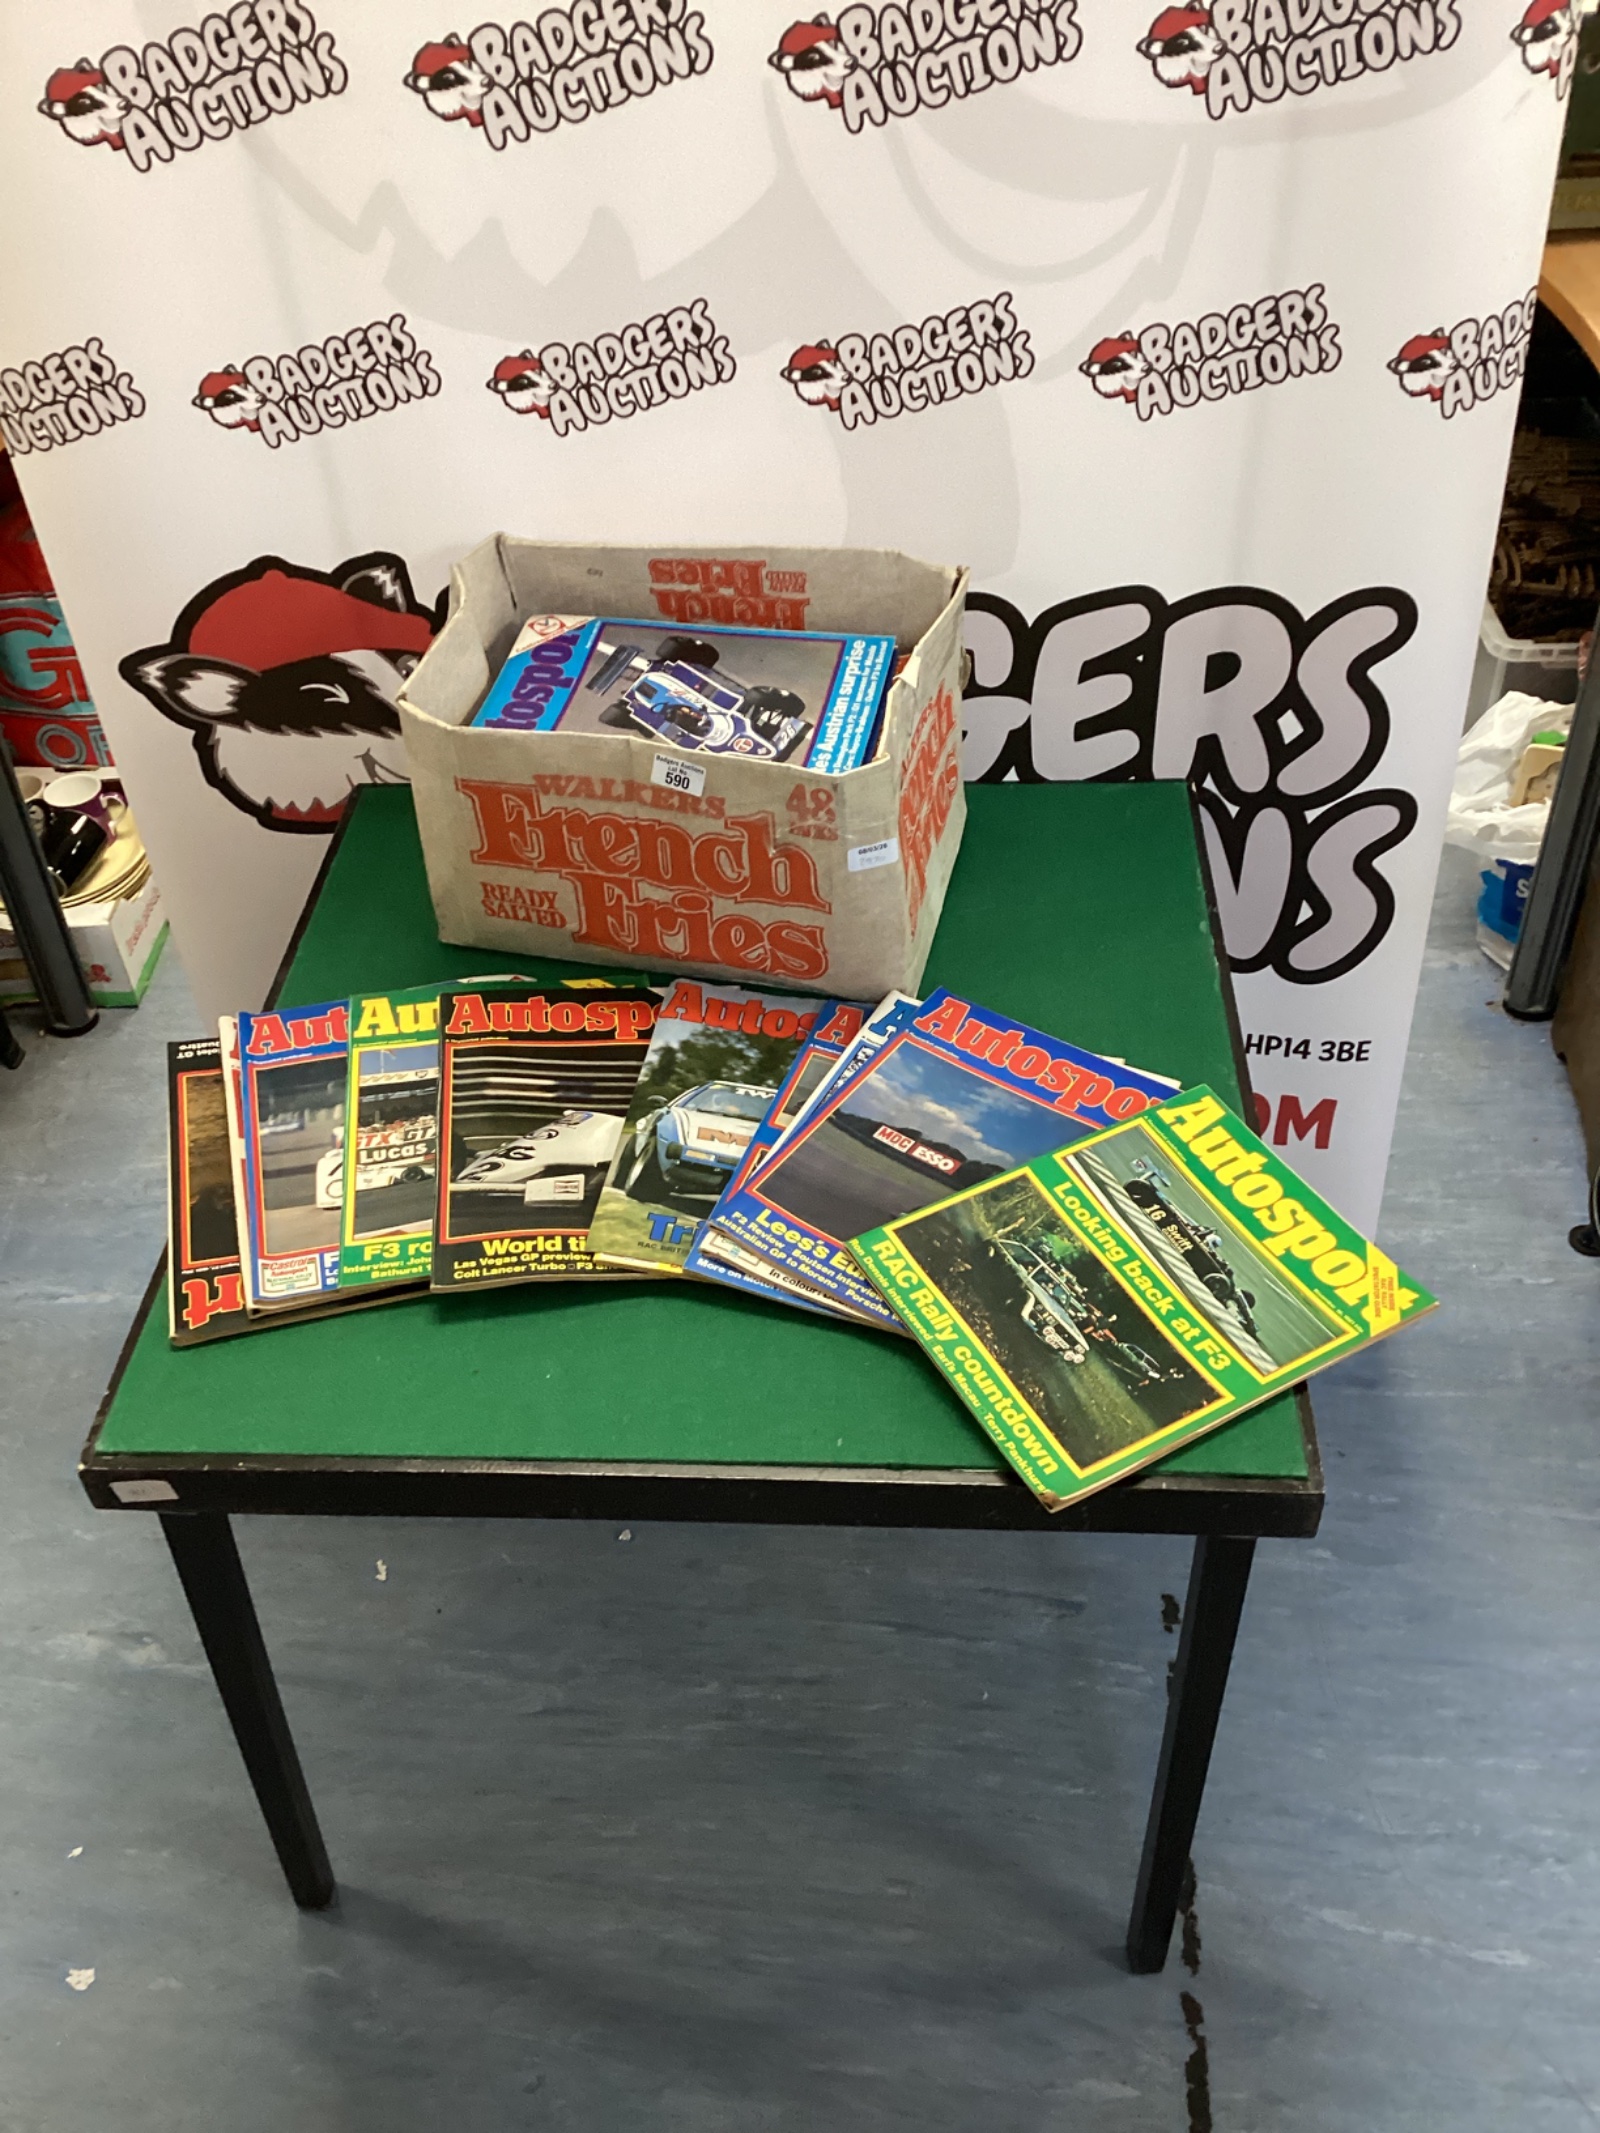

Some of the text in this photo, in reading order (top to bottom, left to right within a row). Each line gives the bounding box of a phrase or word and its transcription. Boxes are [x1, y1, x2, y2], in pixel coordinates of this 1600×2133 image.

[101, 0, 316, 109] BADGERS
[482, 11, 714, 151] AUCTIONS
[842, 0, 1083, 134] AUCTIONS
[1206, 0, 1462, 121] AUCTIONS
[121, 31, 348, 172] AUCTIONS
[243, 313, 416, 403] BADGERS
[540, 297, 715, 393] BADGERS
[838, 291, 1017, 383] BADGERS
[1139, 283, 1328, 371] BADGERS
[258, 350, 441, 449] AUCTIONS
[550, 336, 736, 437] AUCTIONS
[839, 330, 1035, 430] AUCTIONS
[1136, 323, 1342, 422] AUCTIONS
[816, 696, 850, 753] Austrian
[839, 639, 866, 696] surprise
[533, 774, 726, 819] WALKERS
[665, 771, 690, 790] 590
[786, 783, 836, 822] 48
[455, 775, 833, 914] French
[480, 882, 558, 911] READY
[481, 899, 567, 929] SALTED
[559, 868, 829, 979] Fries
[446, 994, 661, 1040] Autosp
[1246, 1033, 1372, 1062] HP14 3BE
[913, 996, 1166, 1121] Autospo
[360, 1143, 428, 1164] Lucas
[879, 1127, 955, 1171] MDC ESSO
[482, 1235, 563, 1256] World
[731, 1211, 749, 1225] F2
[748, 1221, 786, 1249] Review
[791, 1248, 835, 1278] Boutsen
[755, 1208, 830, 1260] Lees's
[1143, 1204, 1167, 1222] 16
[269, 1257, 308, 1271] Castrol
[343, 1261, 405, 1274] Interview:
[364, 1242, 400, 1262] F3
[371, 1266, 423, 1280] Bathurst
[454, 1252, 591, 1270] Las Vegas GP preview
[454, 1269, 480, 1280] Colt
[482, 1265, 527, 1277] Lancer
[529, 1263, 567, 1272] Turbo
[576, 1262, 593, 1270] F3
[696, 1257, 726, 1274] More
[728, 1269, 742, 1280] on
[716, 1214, 769, 1252] Australian
[769, 1247, 787, 1260] GP
[786, 1256, 798, 1267] to
[798, 1262, 839, 1290] Moreno
[844, 1288, 891, 1316] Porsche
[769, 1268, 780, 1279] In
[1053, 1181, 1129, 1261] Looking
[1123, 1257, 1176, 1316] back
[1171, 1317, 1202, 1342] at
[1193, 1338, 1233, 1371] F3
[851, 1238, 865, 1257] Ron
[863, 1255, 890, 1288] Dennis
[886, 1286, 931, 1342] interviewed
[954, 1372, 981, 1408] Macau
[983, 1412, 1007, 1442] Terry
[871, 1239, 918, 1289] RAC
[909, 1286, 959, 1342] Rally
[953, 1345, 1060, 1476] countdown
